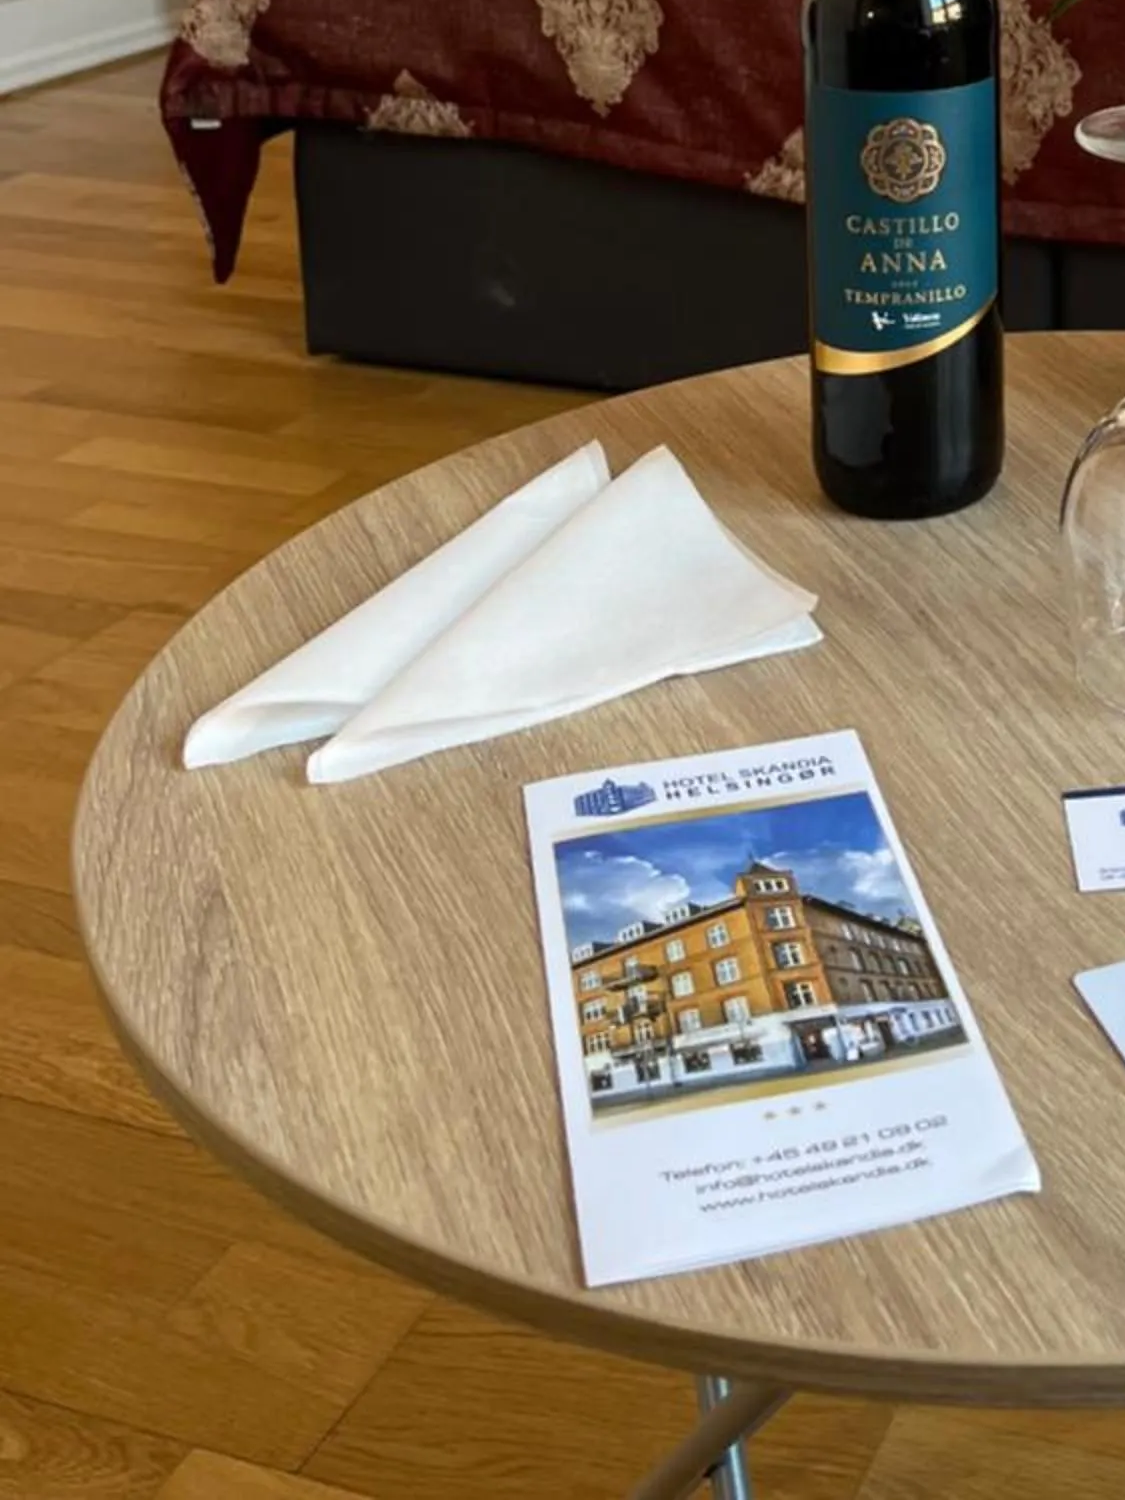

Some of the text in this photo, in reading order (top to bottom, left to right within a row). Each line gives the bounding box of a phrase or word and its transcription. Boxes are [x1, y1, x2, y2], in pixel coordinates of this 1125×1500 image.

[846, 212, 960, 235] CASTILLO
[860, 249, 947, 273] ANNA
[844, 284, 967, 305] TEMPRANILLO
[662, 755, 832, 790] HOTEL SKANDIA
[665, 765, 836, 801] HELSINGØR
[660, 1158, 745, 1183] Telefon:
[752, 1148, 800, 1165] +45
[842, 1133, 870, 1148] 21
[914, 1114, 948, 1132] 02
[696, 1139, 926, 1195] info@hotelskandia.dk
[699, 1157, 932, 1213] www.hotelskandia.dk
